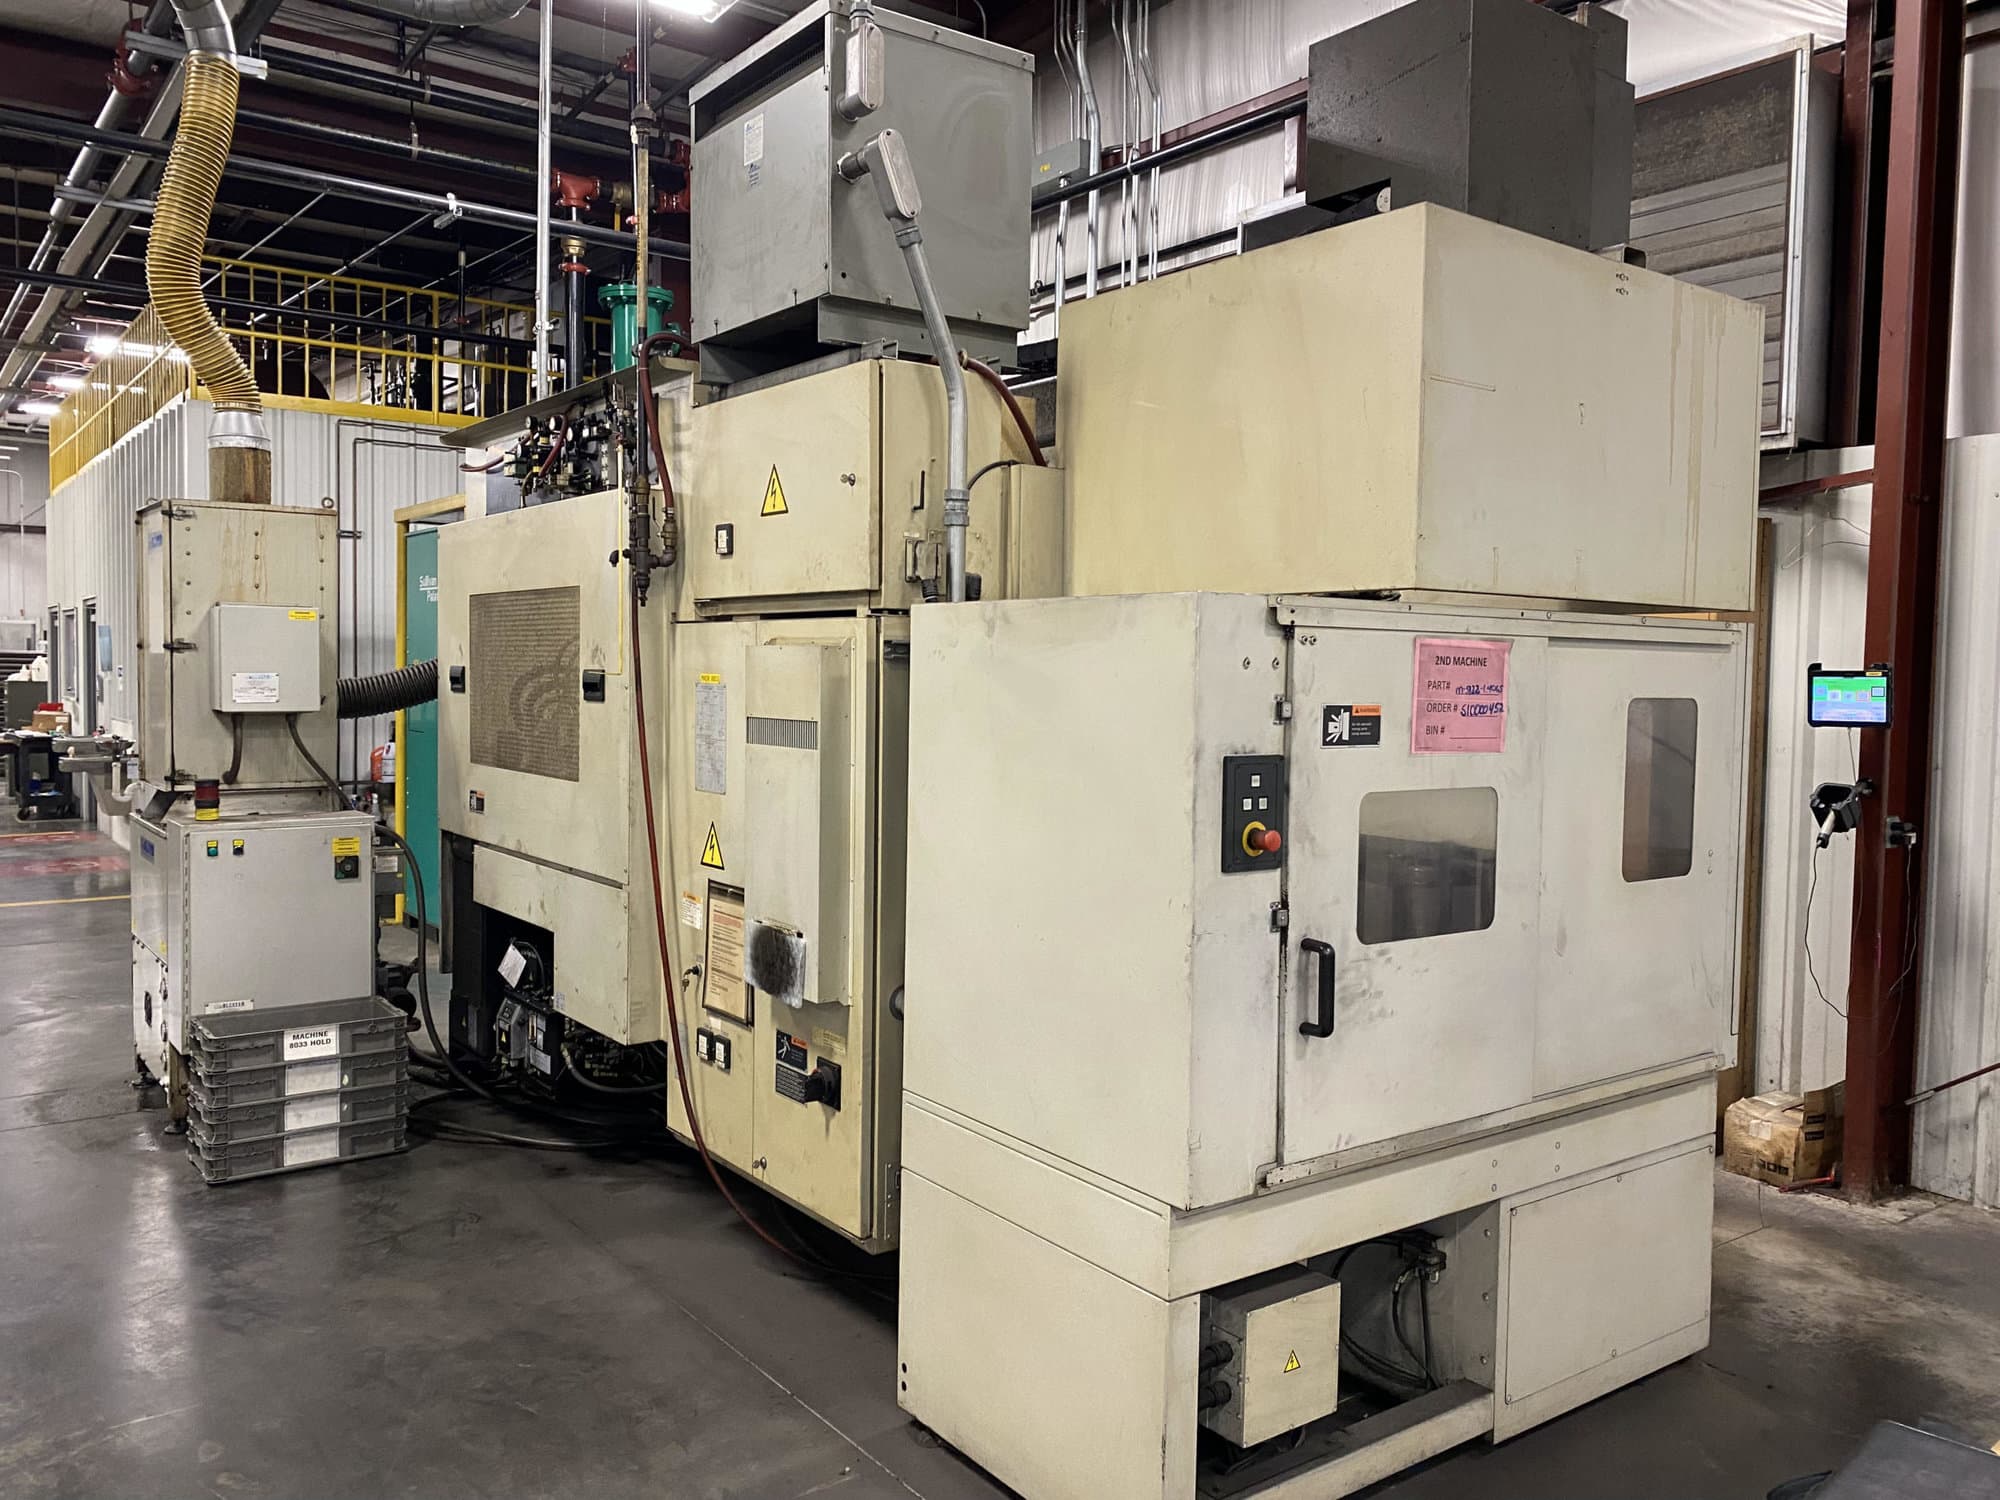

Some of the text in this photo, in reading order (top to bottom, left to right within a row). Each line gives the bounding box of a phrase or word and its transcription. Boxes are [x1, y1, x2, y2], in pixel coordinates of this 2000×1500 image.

[1435, 655, 1488, 667] 2ND MACHINE
[1427, 680, 1451, 691] PART#
[1426, 703, 1452, 713] ORDER
[1453, 704, 1458, 713] #
[1425, 725, 1446, 736] BIN #
[292, 1030, 329, 1040] MACHINE
[310, 1037, 331, 1046] HOLD
